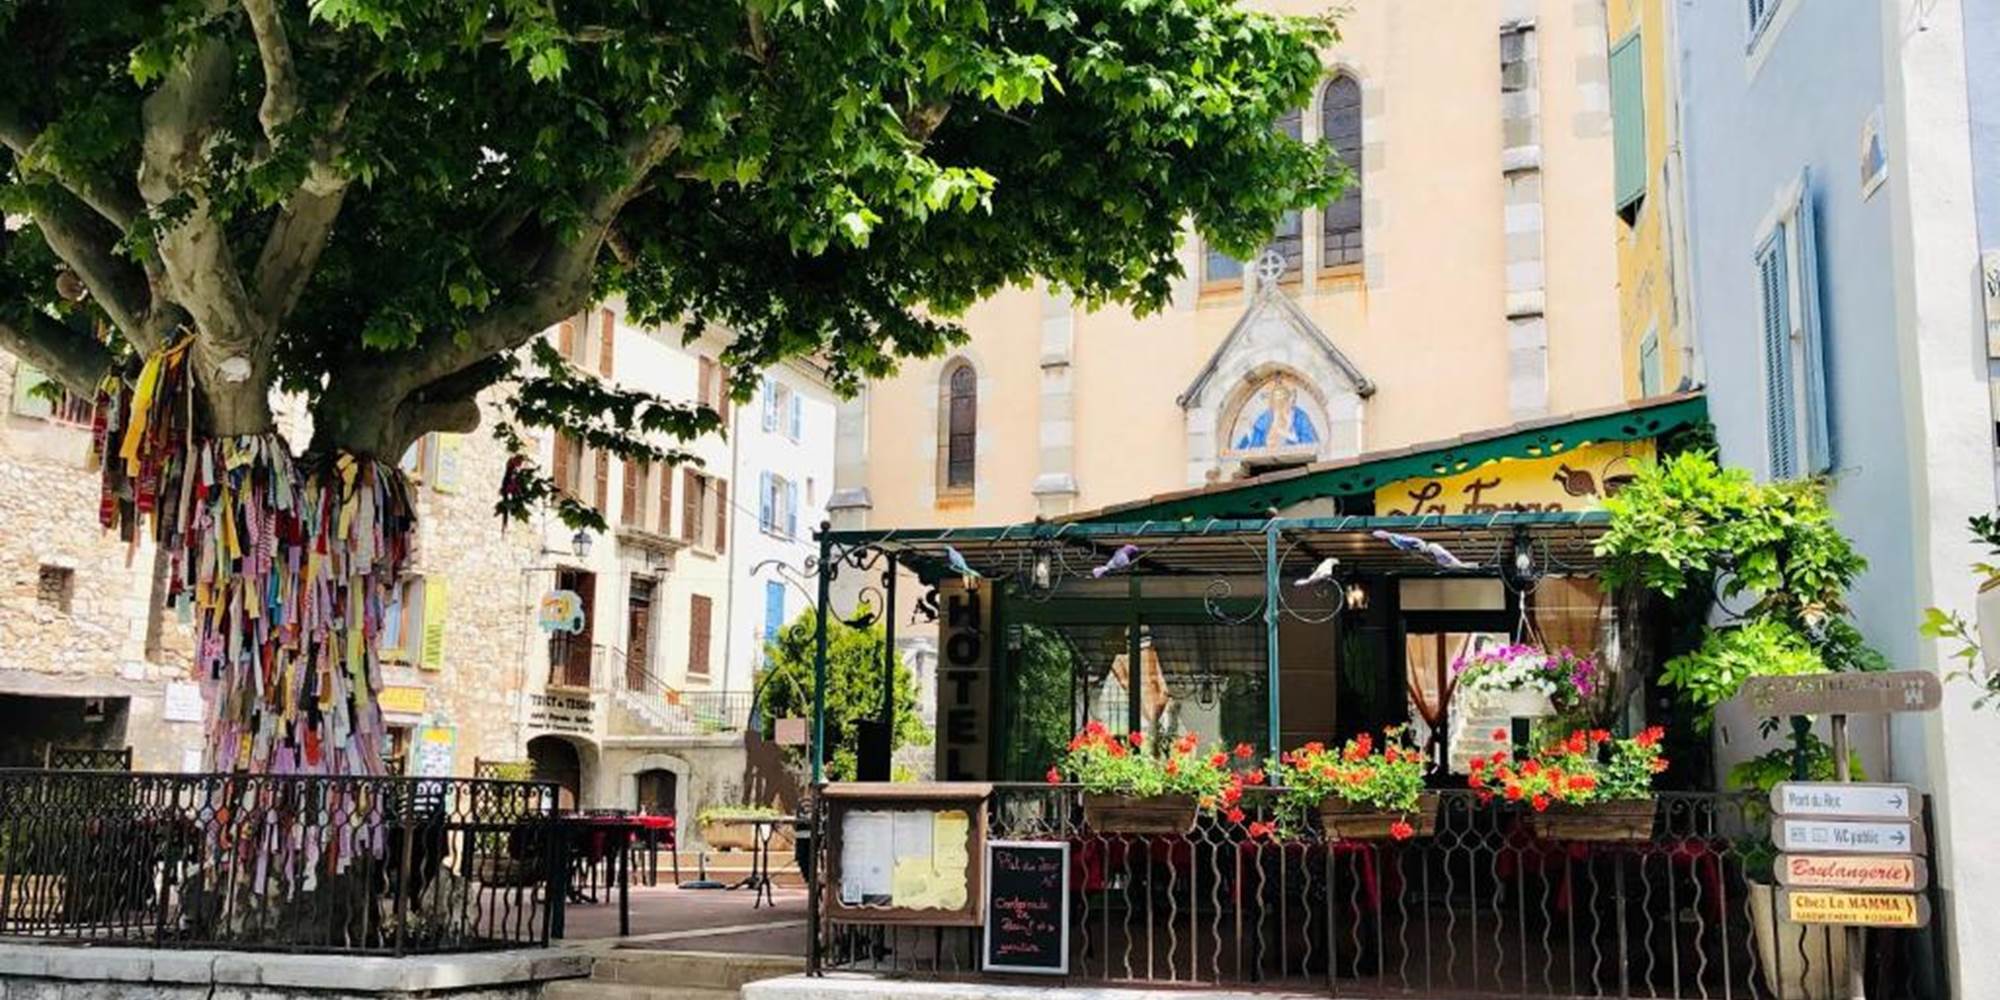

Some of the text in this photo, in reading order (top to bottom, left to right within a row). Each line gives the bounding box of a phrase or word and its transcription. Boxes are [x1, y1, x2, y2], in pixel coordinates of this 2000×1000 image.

[1388, 482, 1445, 515] La
[1833, 827, 1849, 843] WC
[1792, 858, 1901, 883] Boulangerie
[1795, 895, 1900, 910] Chez La MAMMA
